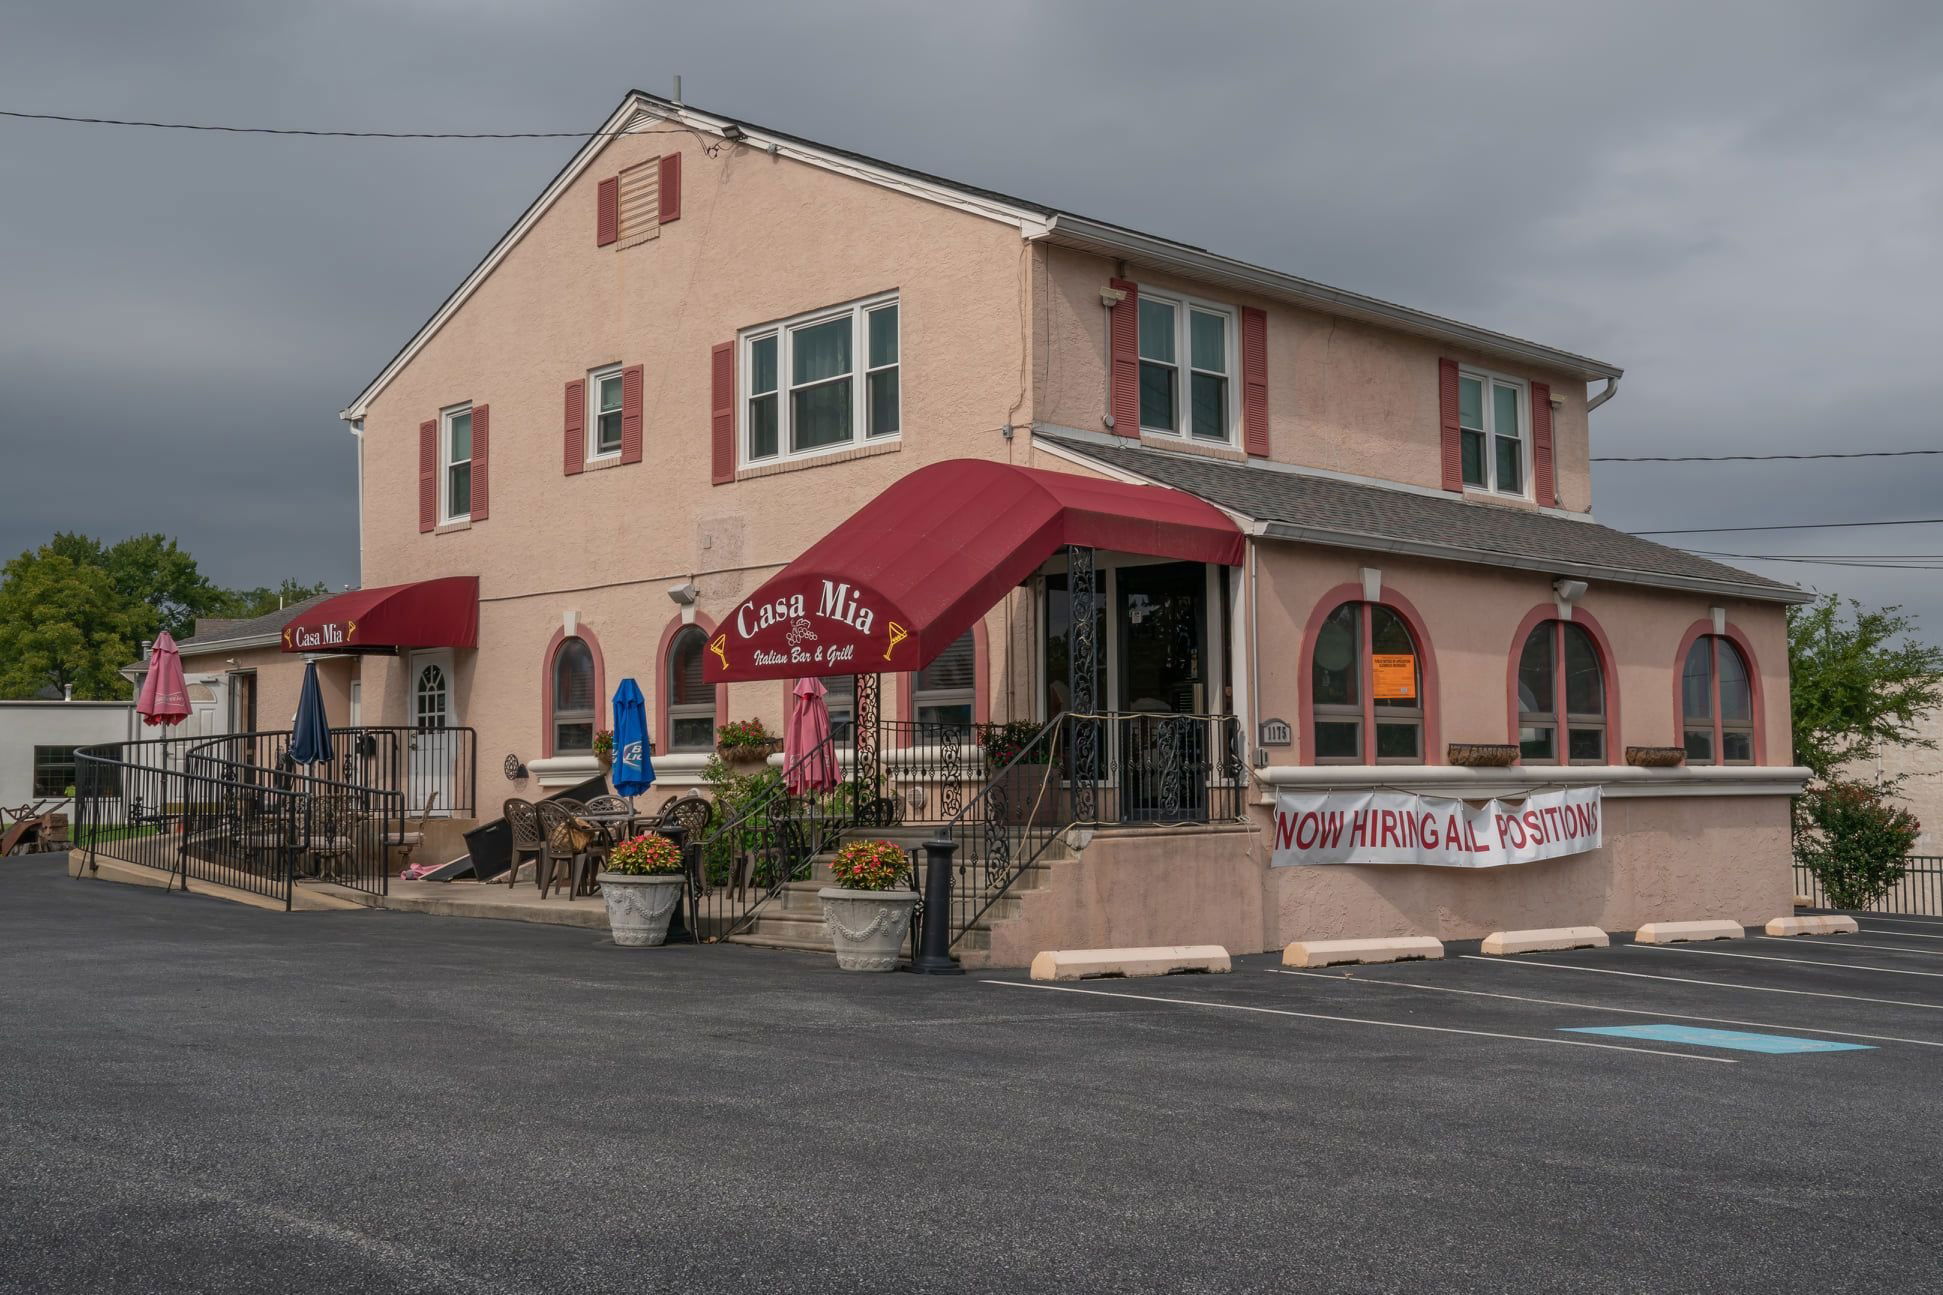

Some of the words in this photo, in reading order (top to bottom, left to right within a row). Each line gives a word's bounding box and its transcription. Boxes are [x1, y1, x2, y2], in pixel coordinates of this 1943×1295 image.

[736, 593, 806, 639] Casa
[816, 579, 875, 634] Mia
[295, 626, 320, 648] Casa
[322, 623, 342, 645] Mia
[753, 649, 788, 666] Italian
[791, 646, 811, 662] Bar
[814, 645, 823, 661] &
[827, 644, 854, 667] Grill
[1275, 810, 1345, 851] NOW
[1350, 808, 1440, 851] HIRING
[1445, 814, 1490, 853] ALL
[1494, 799, 1598, 850] POSITIONS
